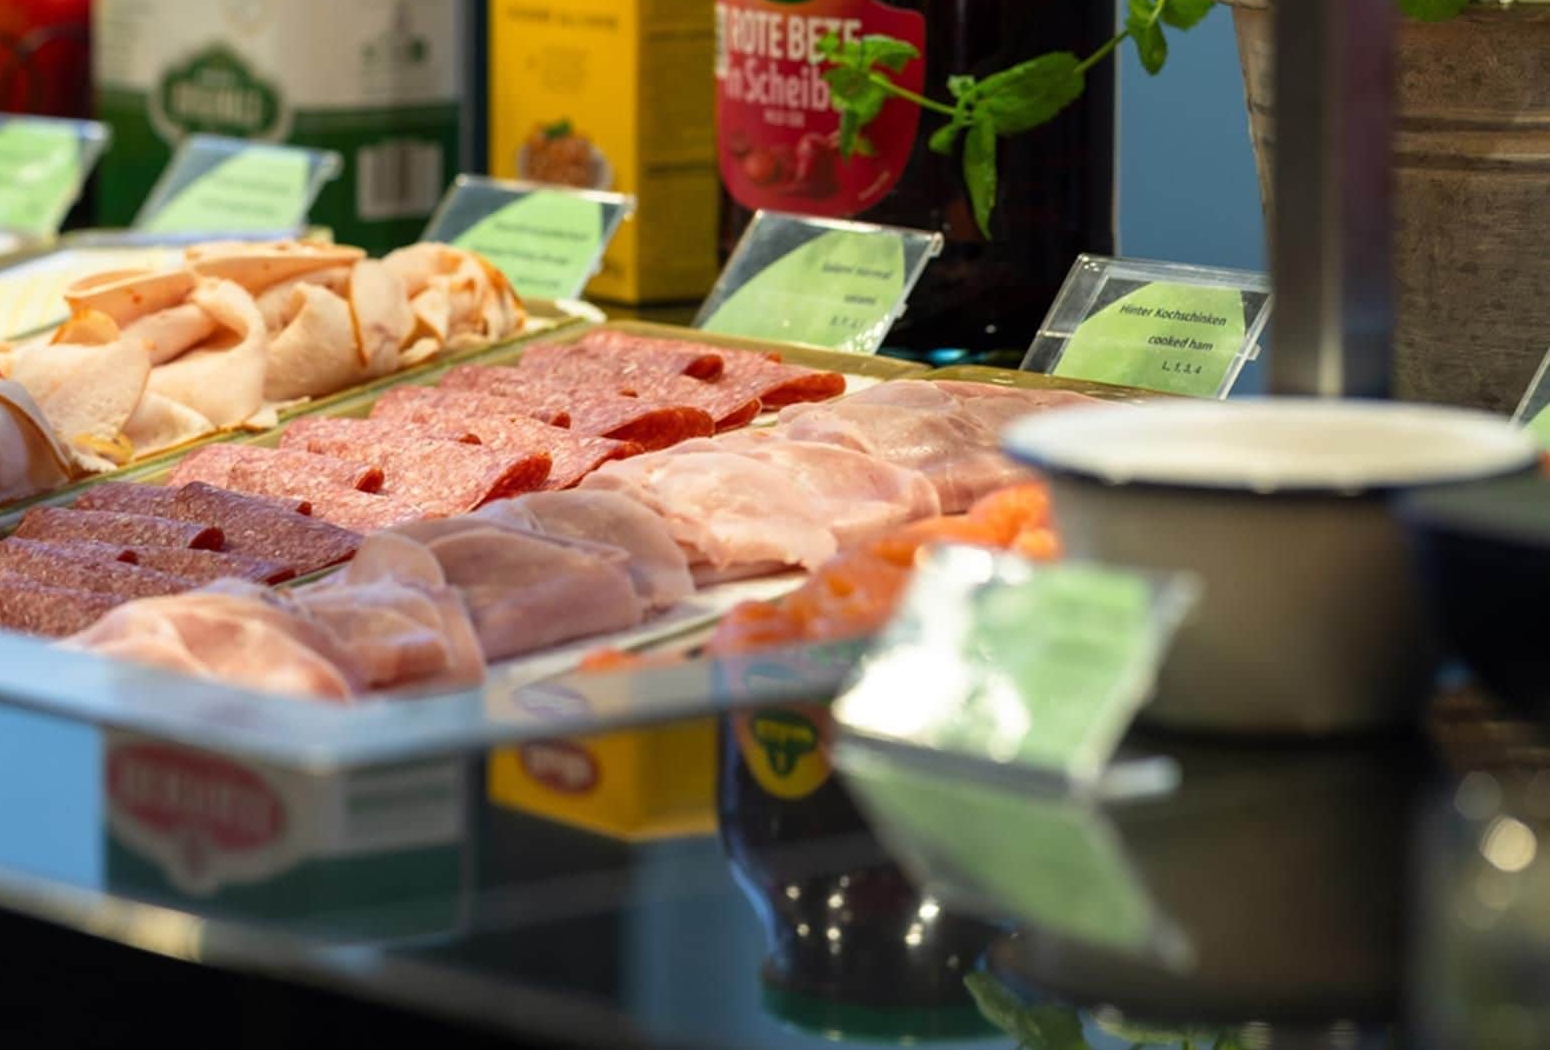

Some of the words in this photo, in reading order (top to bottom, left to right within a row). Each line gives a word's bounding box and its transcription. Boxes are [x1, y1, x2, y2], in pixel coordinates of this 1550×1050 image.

[744, 55, 836, 111] Scheib
[1119, 303, 1152, 317] Hinter
[1153, 307, 1227, 327] Kochschinken
[1147, 334, 1190, 349] cooked
[1189, 337, 1214, 351] ham
